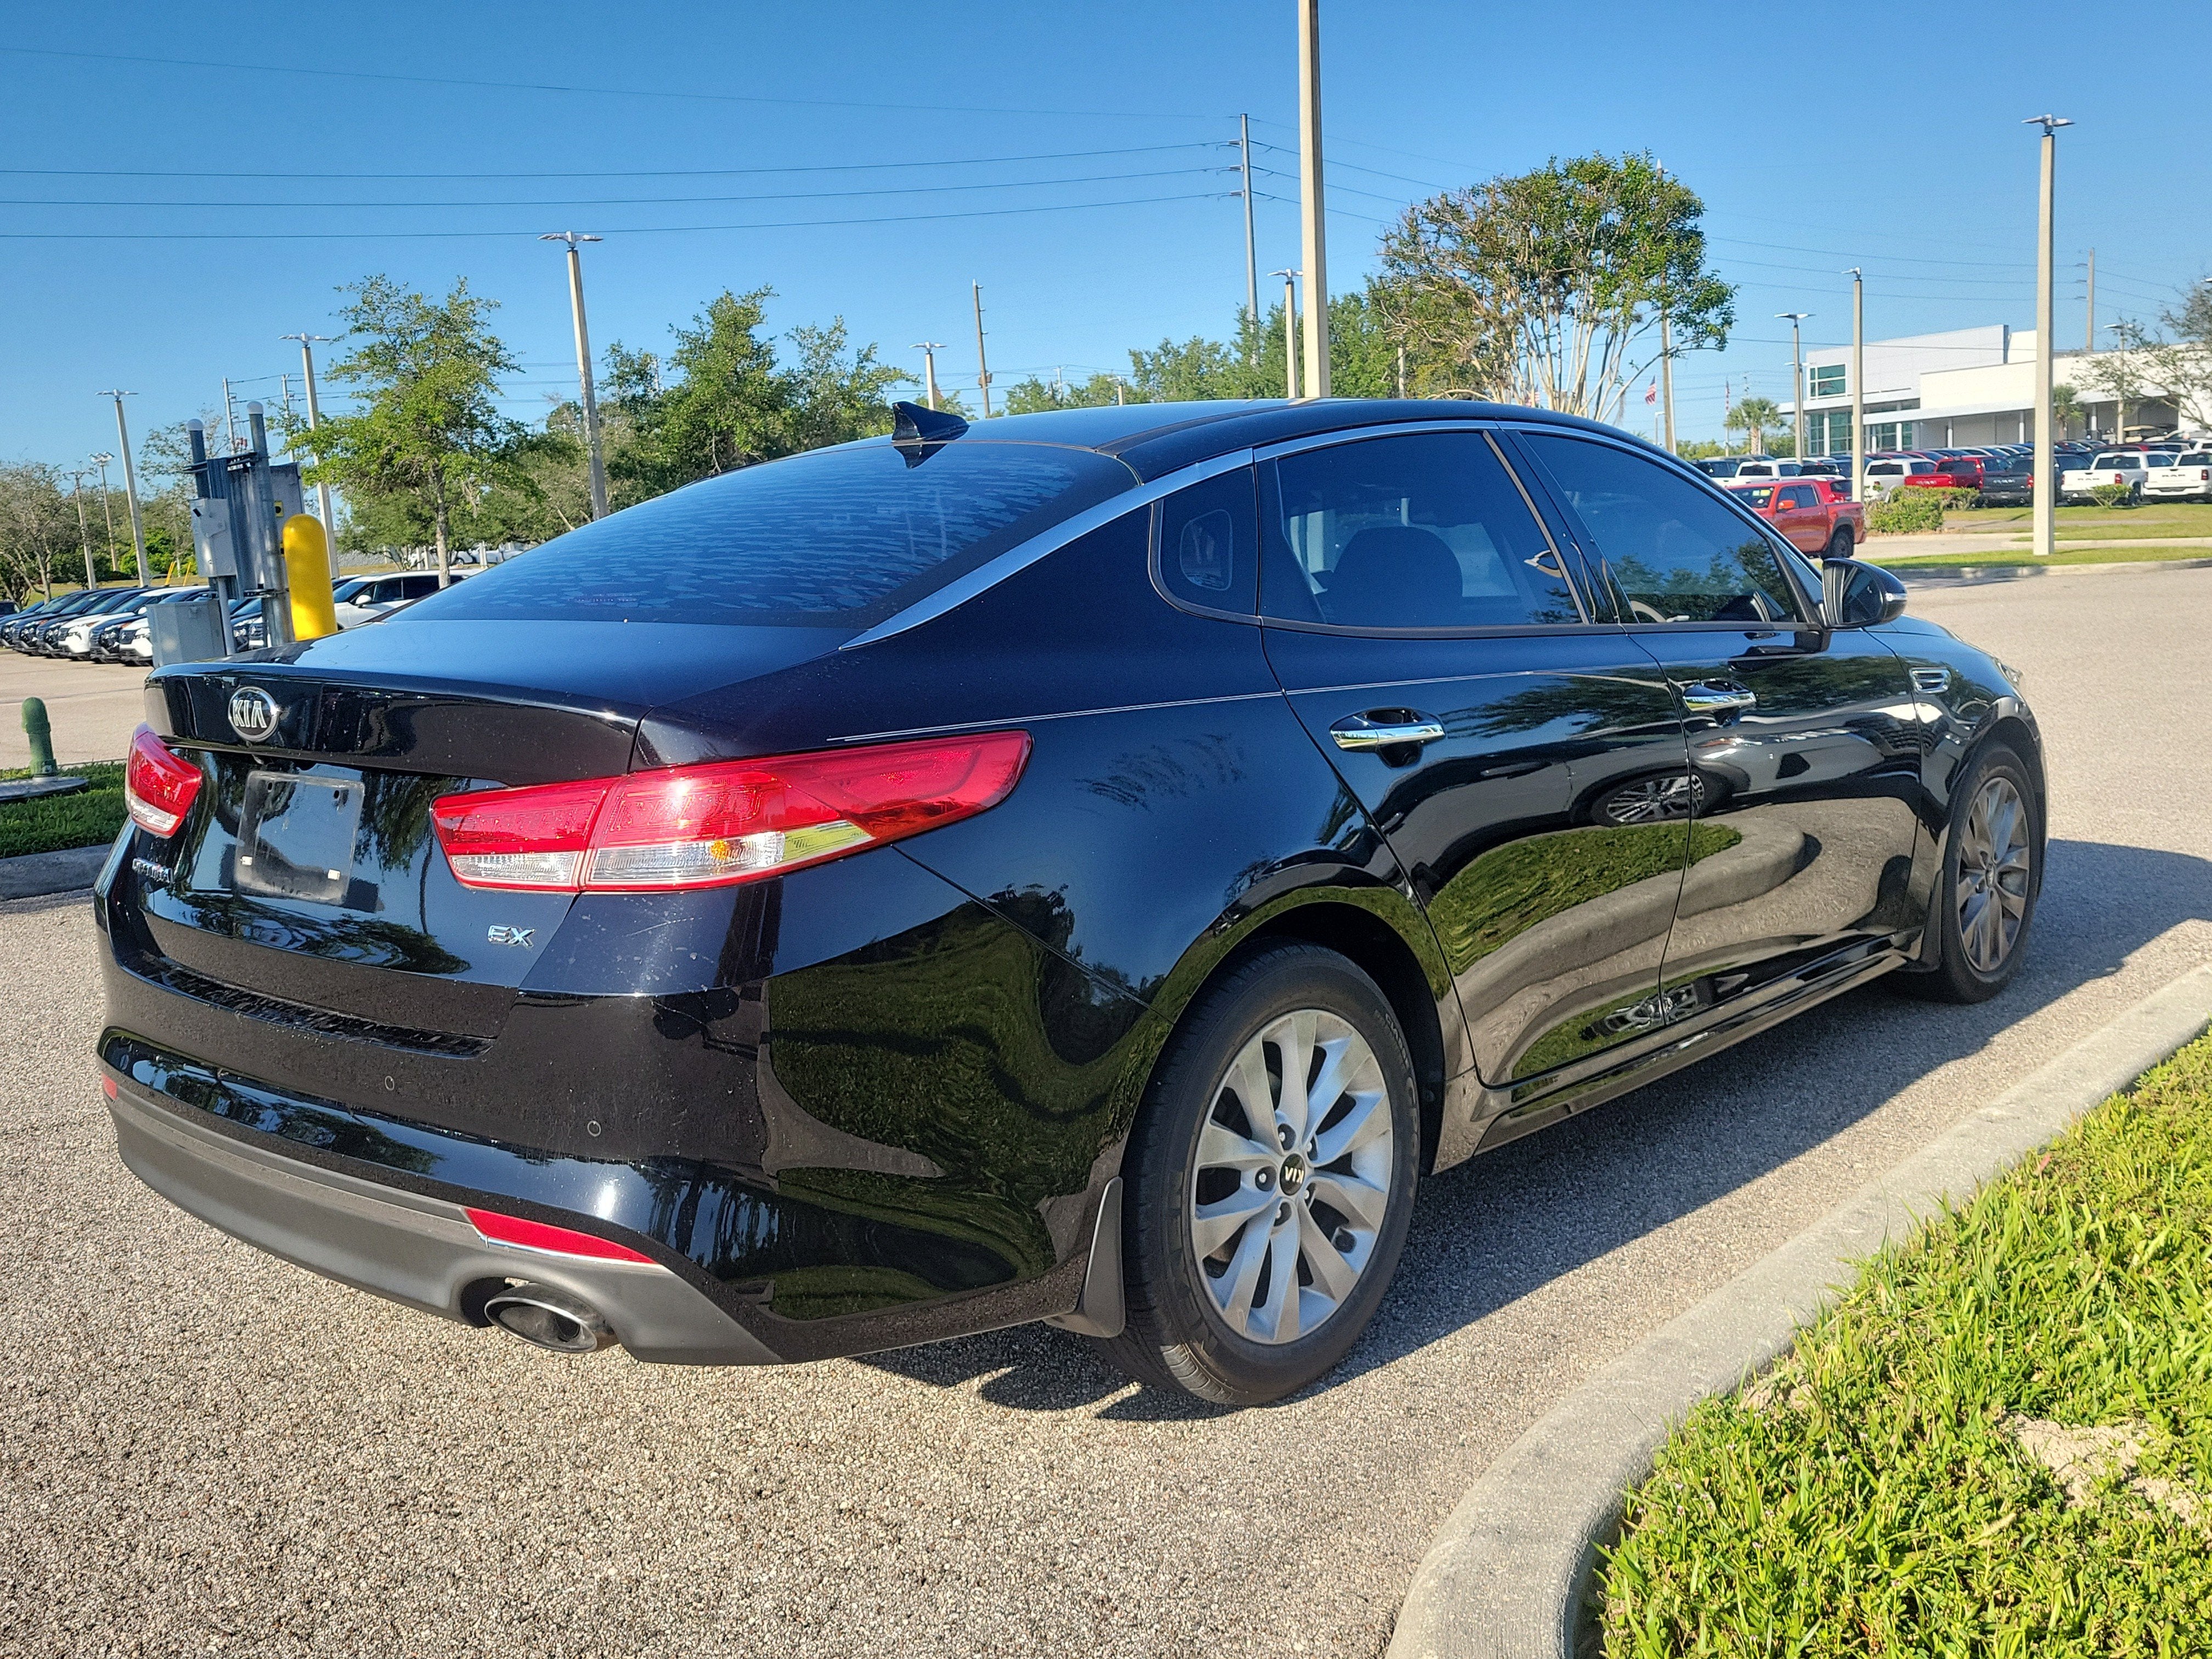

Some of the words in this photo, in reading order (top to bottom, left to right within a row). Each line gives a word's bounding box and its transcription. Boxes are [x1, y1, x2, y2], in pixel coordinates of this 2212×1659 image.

[233, 699, 267, 728] KIA
[488, 925, 535, 946] EX
[1285, 1166, 1305, 1184] KIA
